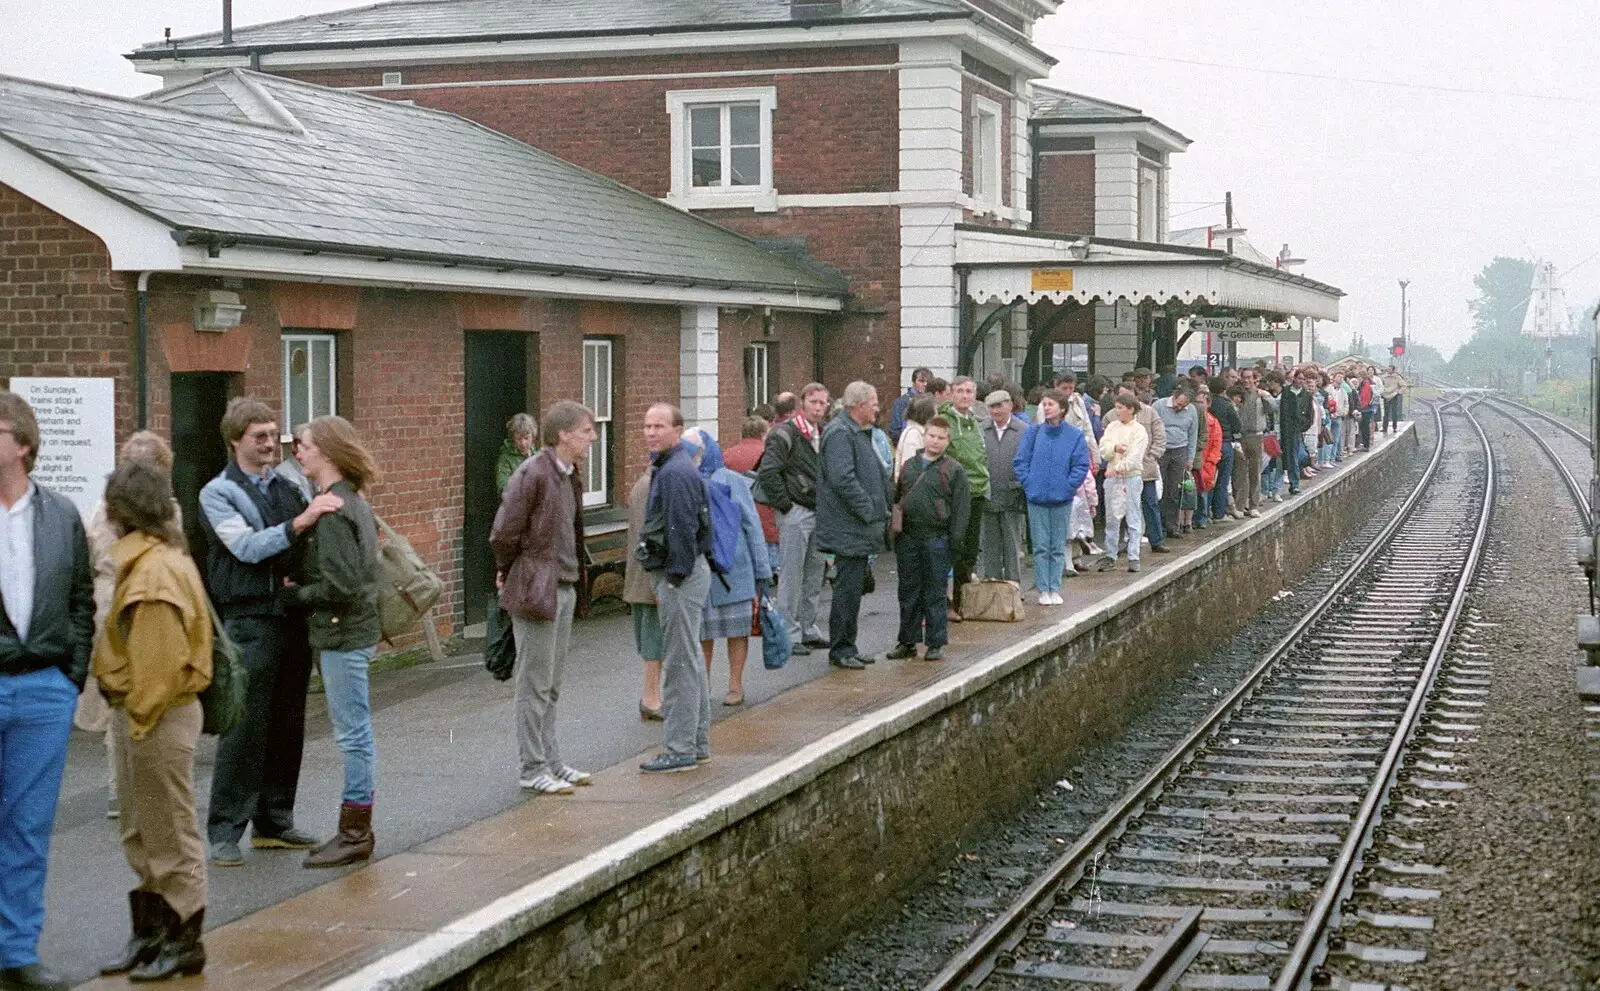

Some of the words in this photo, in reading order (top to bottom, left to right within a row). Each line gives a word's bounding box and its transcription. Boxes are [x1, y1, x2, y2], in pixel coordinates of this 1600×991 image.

[1205, 320, 1226, 329] Way
[1227, 320, 1242, 328] out
[1210, 354, 1216, 363] 2
[30, 386, 41, 394] On
[30, 396, 52, 404] trains
[54, 396, 72, 405] stop
[42, 464, 62, 472] alight
